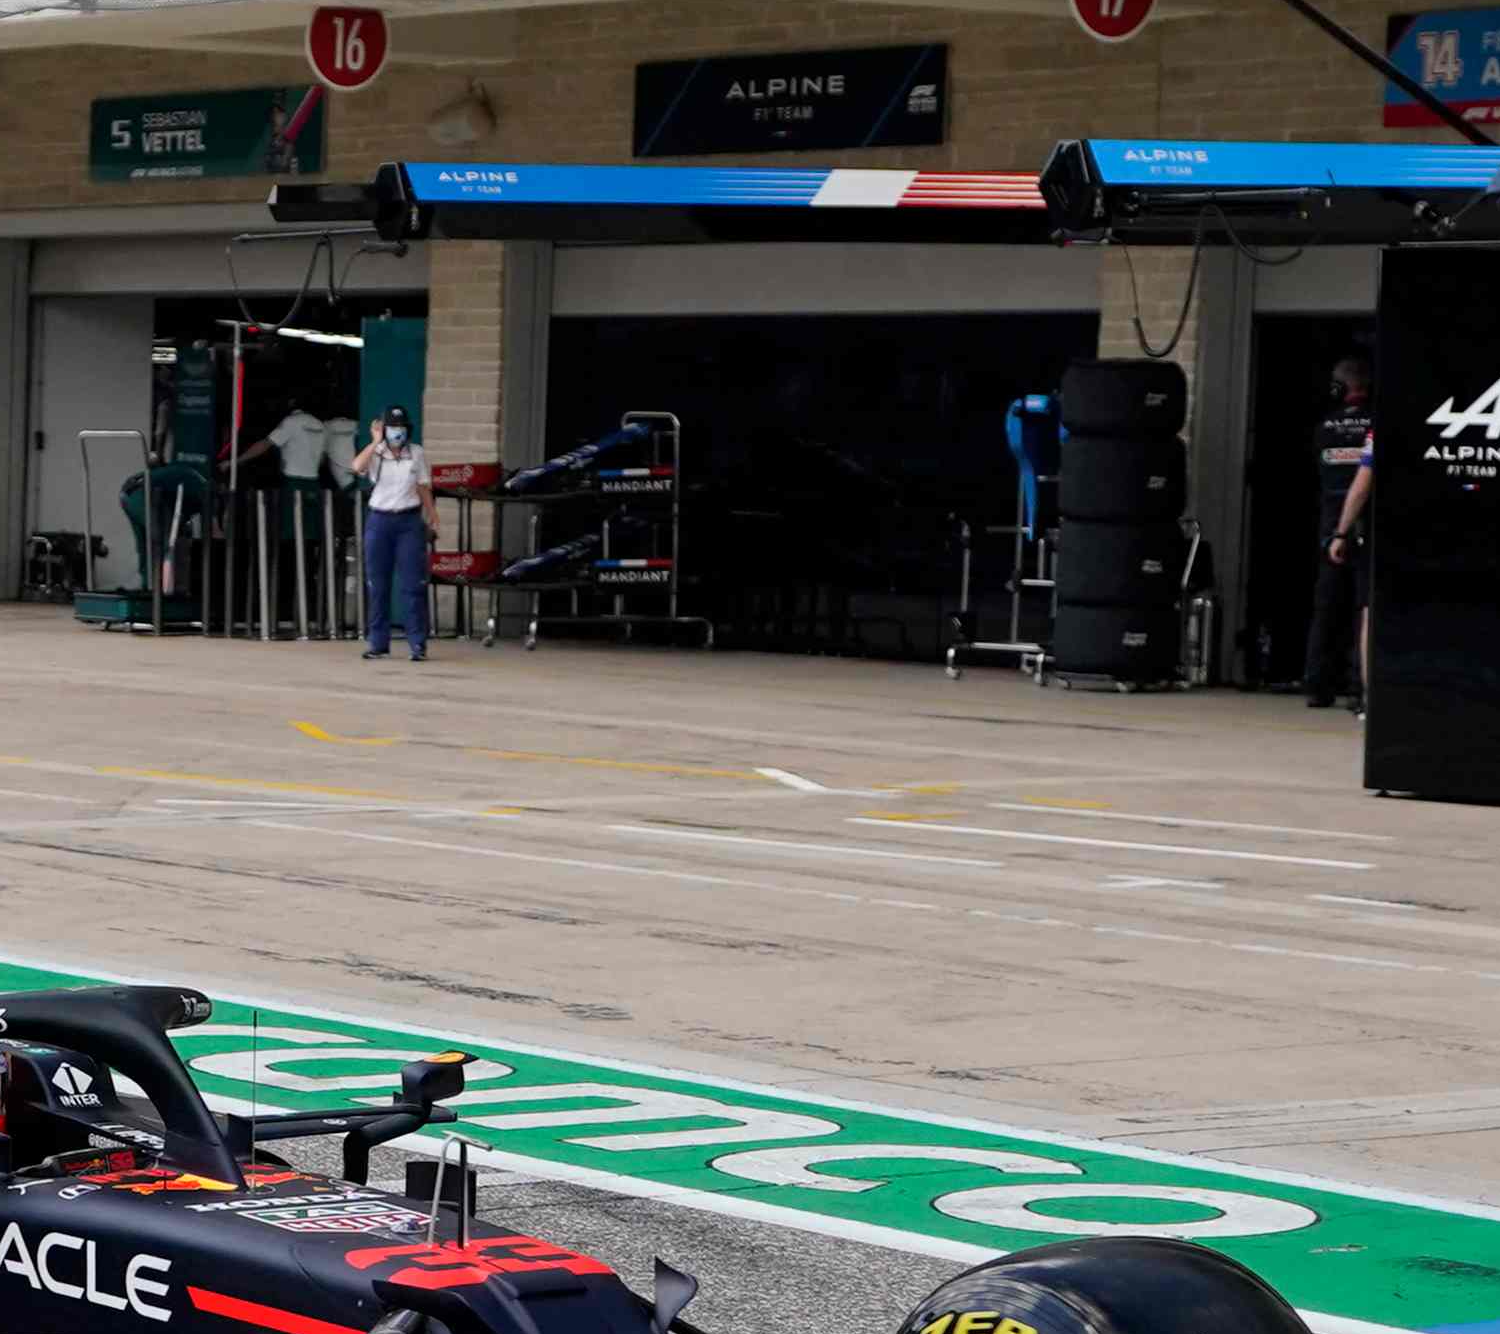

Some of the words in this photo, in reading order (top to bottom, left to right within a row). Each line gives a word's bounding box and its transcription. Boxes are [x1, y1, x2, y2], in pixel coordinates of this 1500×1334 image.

[332, 17, 366, 70] 16
[1417, 30, 1463, 86] 14
[726, 75, 845, 99] ALPINE
[142, 111, 207, 128] SEBASTIAN
[777, 107, 813, 120] TEAM
[111, 120, 131, 148] 5
[142, 130, 206, 153] VETTEL
[1124, 149, 1209, 163] ALPINE
[438, 171, 519, 183] ALPINE
[1466, 466, 1497, 477] TEAM
[602, 480, 673, 492] MANDIANT
[599, 570, 670, 582] MANDIANT
[59, 1094, 100, 1107] INTER
[184, 1193, 388, 1212] HONDA
[258, 1205, 392, 1220] TAG
[345, 1236, 602, 1289] 33
